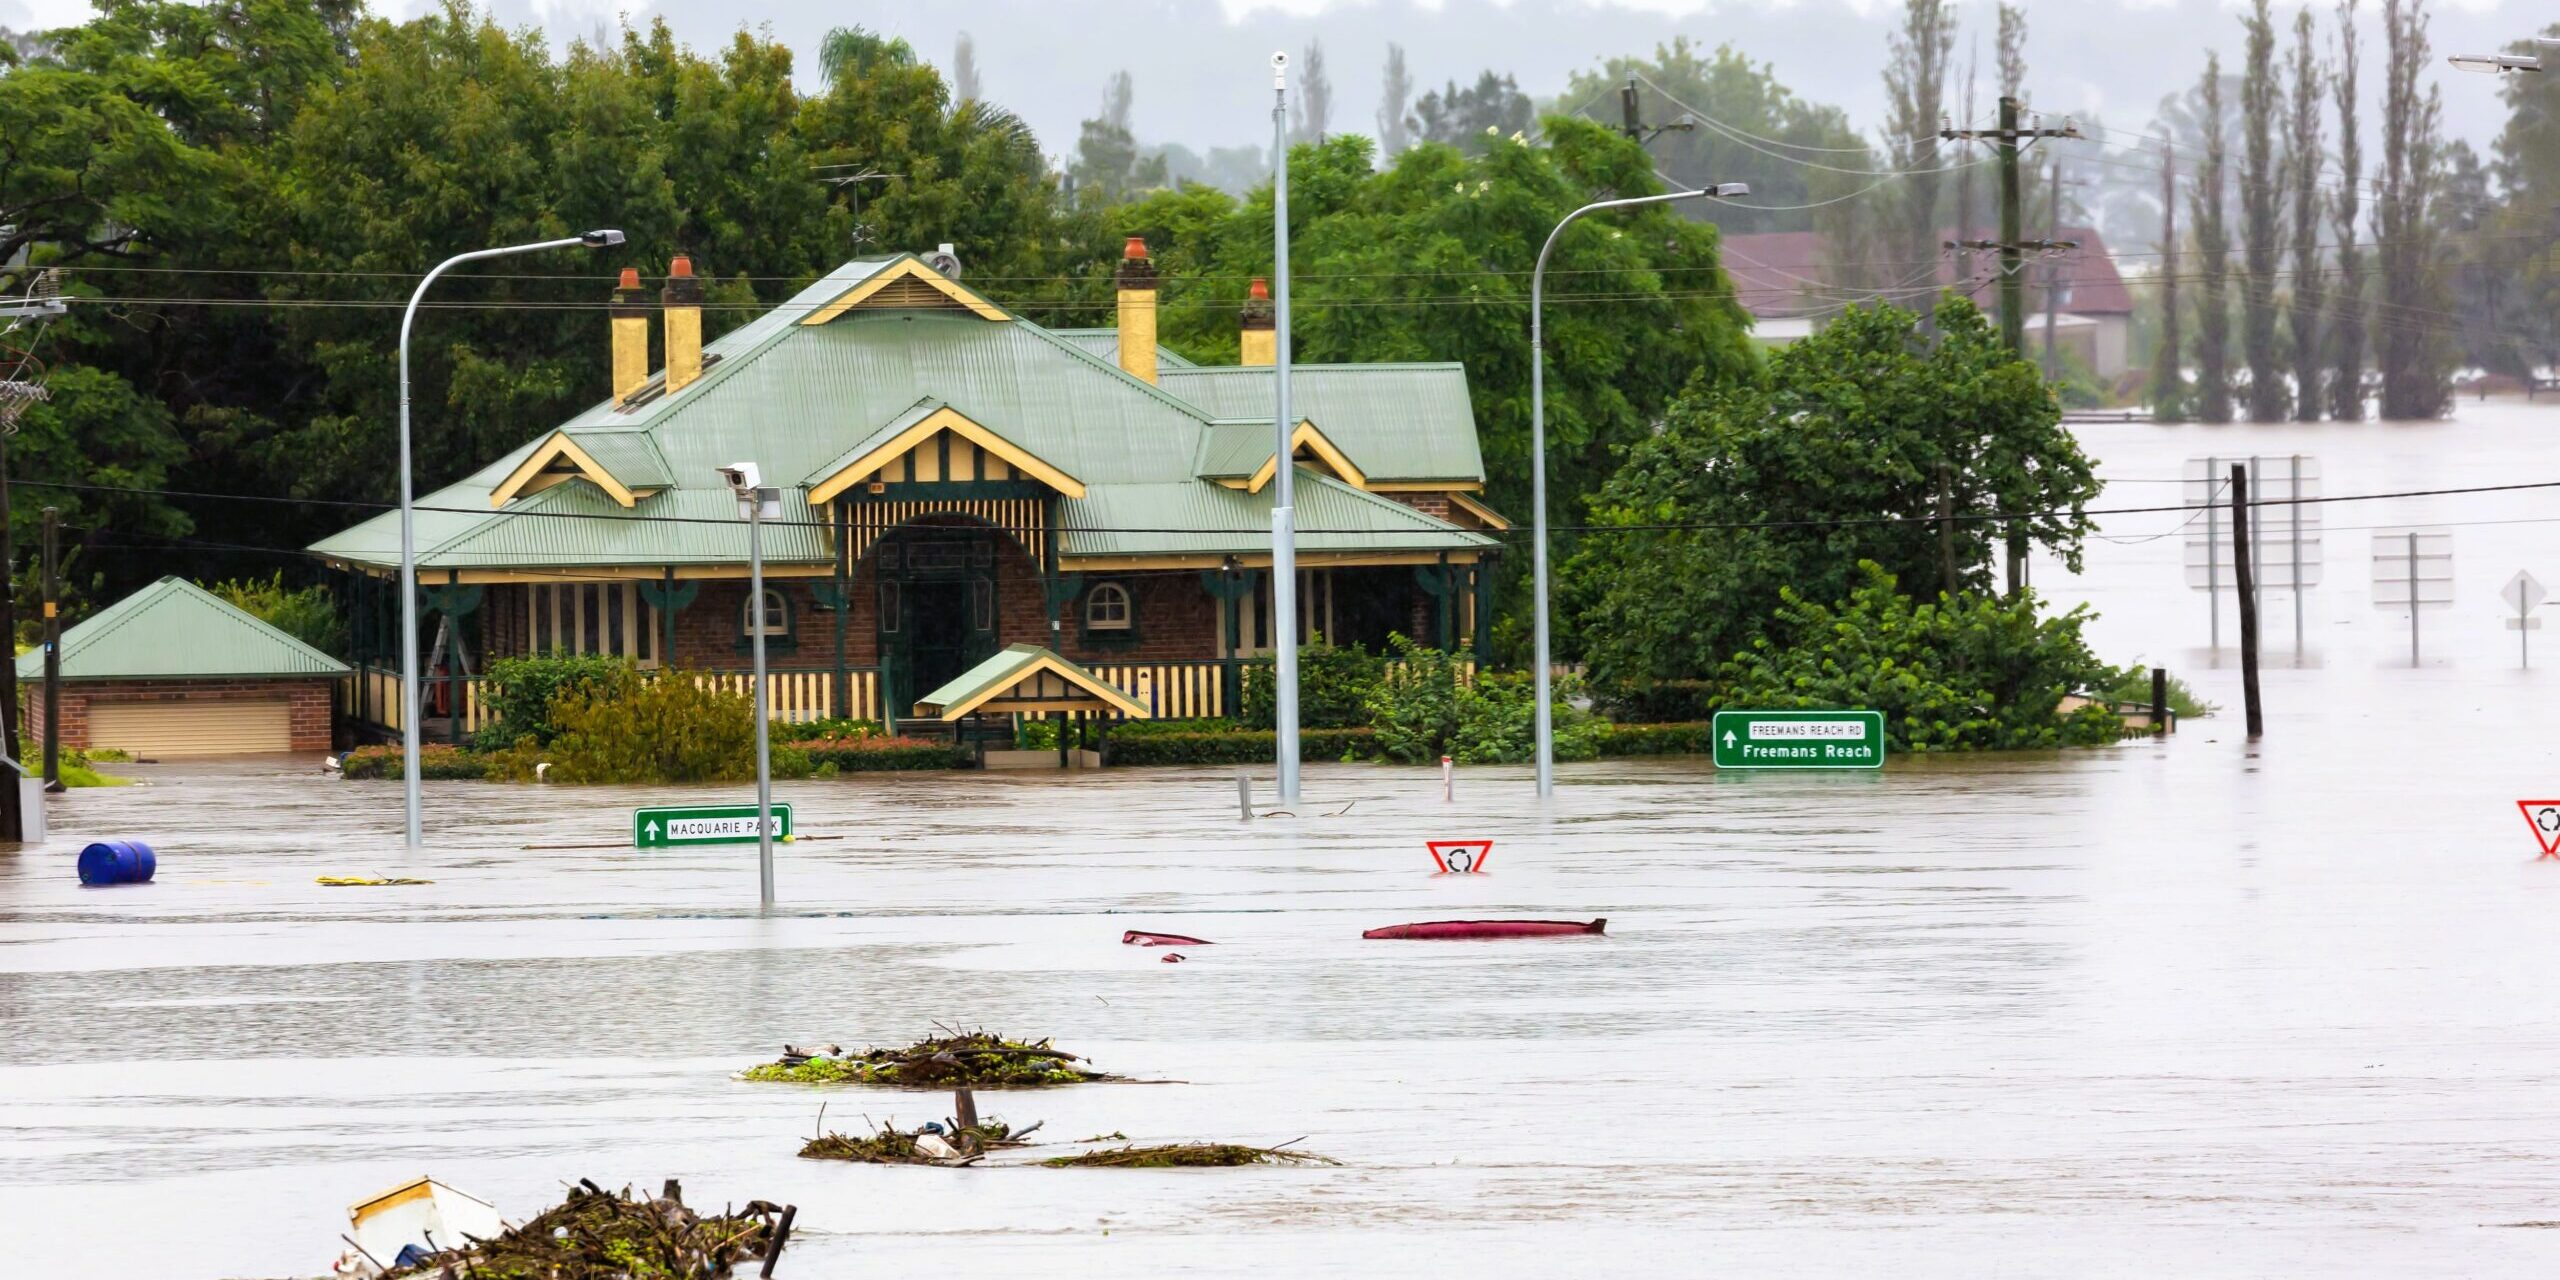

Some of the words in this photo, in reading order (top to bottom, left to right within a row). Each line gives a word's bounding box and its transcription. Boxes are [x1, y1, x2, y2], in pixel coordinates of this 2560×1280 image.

[1752, 725, 1805, 736] FREEMANS
[1810, 725, 1844, 736] REACH
[1849, 725, 1862, 736] RD
[1743, 744, 1818, 758] Freemans
[1825, 744, 1872, 758] Reach
[671, 822, 741, 835] MACQUARIE
[746, 821, 778, 833] PAK
